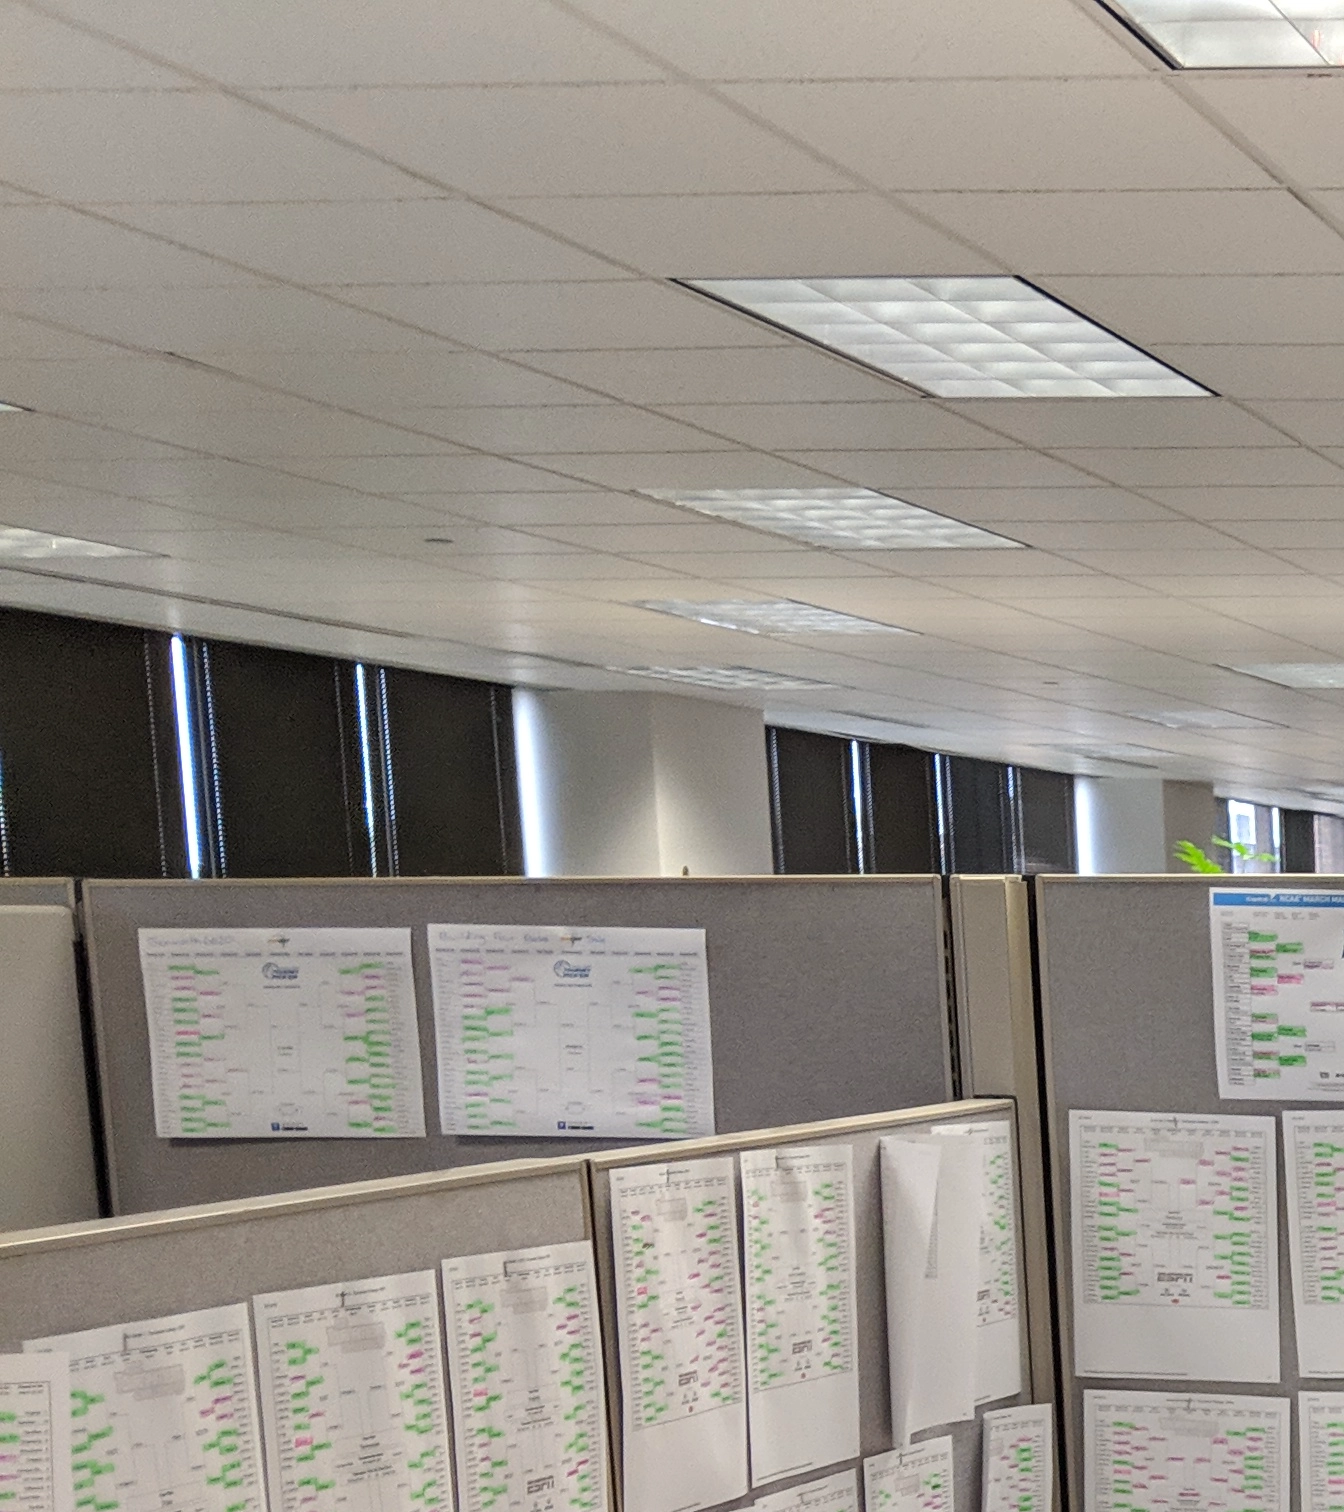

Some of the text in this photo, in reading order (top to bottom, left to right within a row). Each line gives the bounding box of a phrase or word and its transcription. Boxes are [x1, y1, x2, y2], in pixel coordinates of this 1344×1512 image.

[1302, 896, 1330, 904] MARCH
[1157, 1272, 1193, 1283] ESPN
[527, 1475, 554, 1494] ESPN
